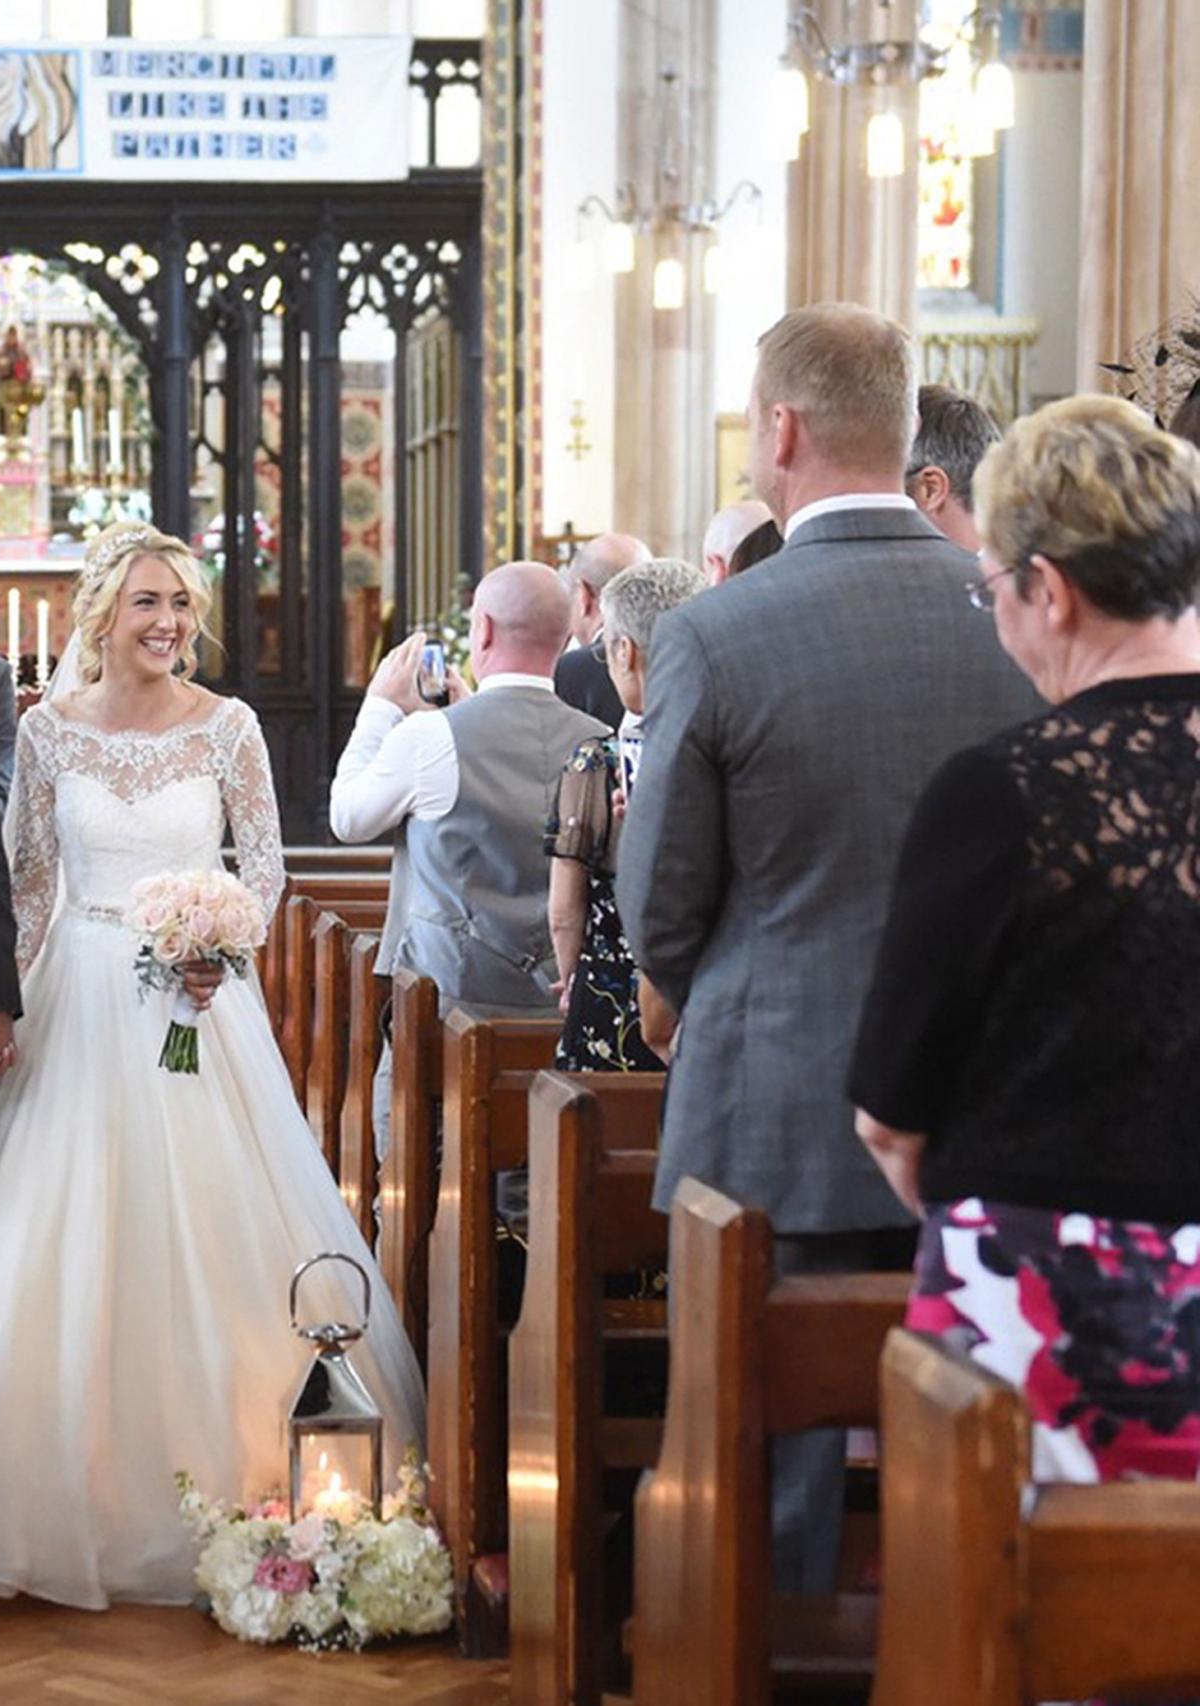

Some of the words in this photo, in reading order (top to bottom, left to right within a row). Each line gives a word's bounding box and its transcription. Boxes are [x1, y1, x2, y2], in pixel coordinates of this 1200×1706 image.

[93, 50, 336, 81] MERCIFUL
[108, 91, 225, 119] LIKE
[242, 93, 327, 121] THE
[112, 131, 297, 159] FATHER
